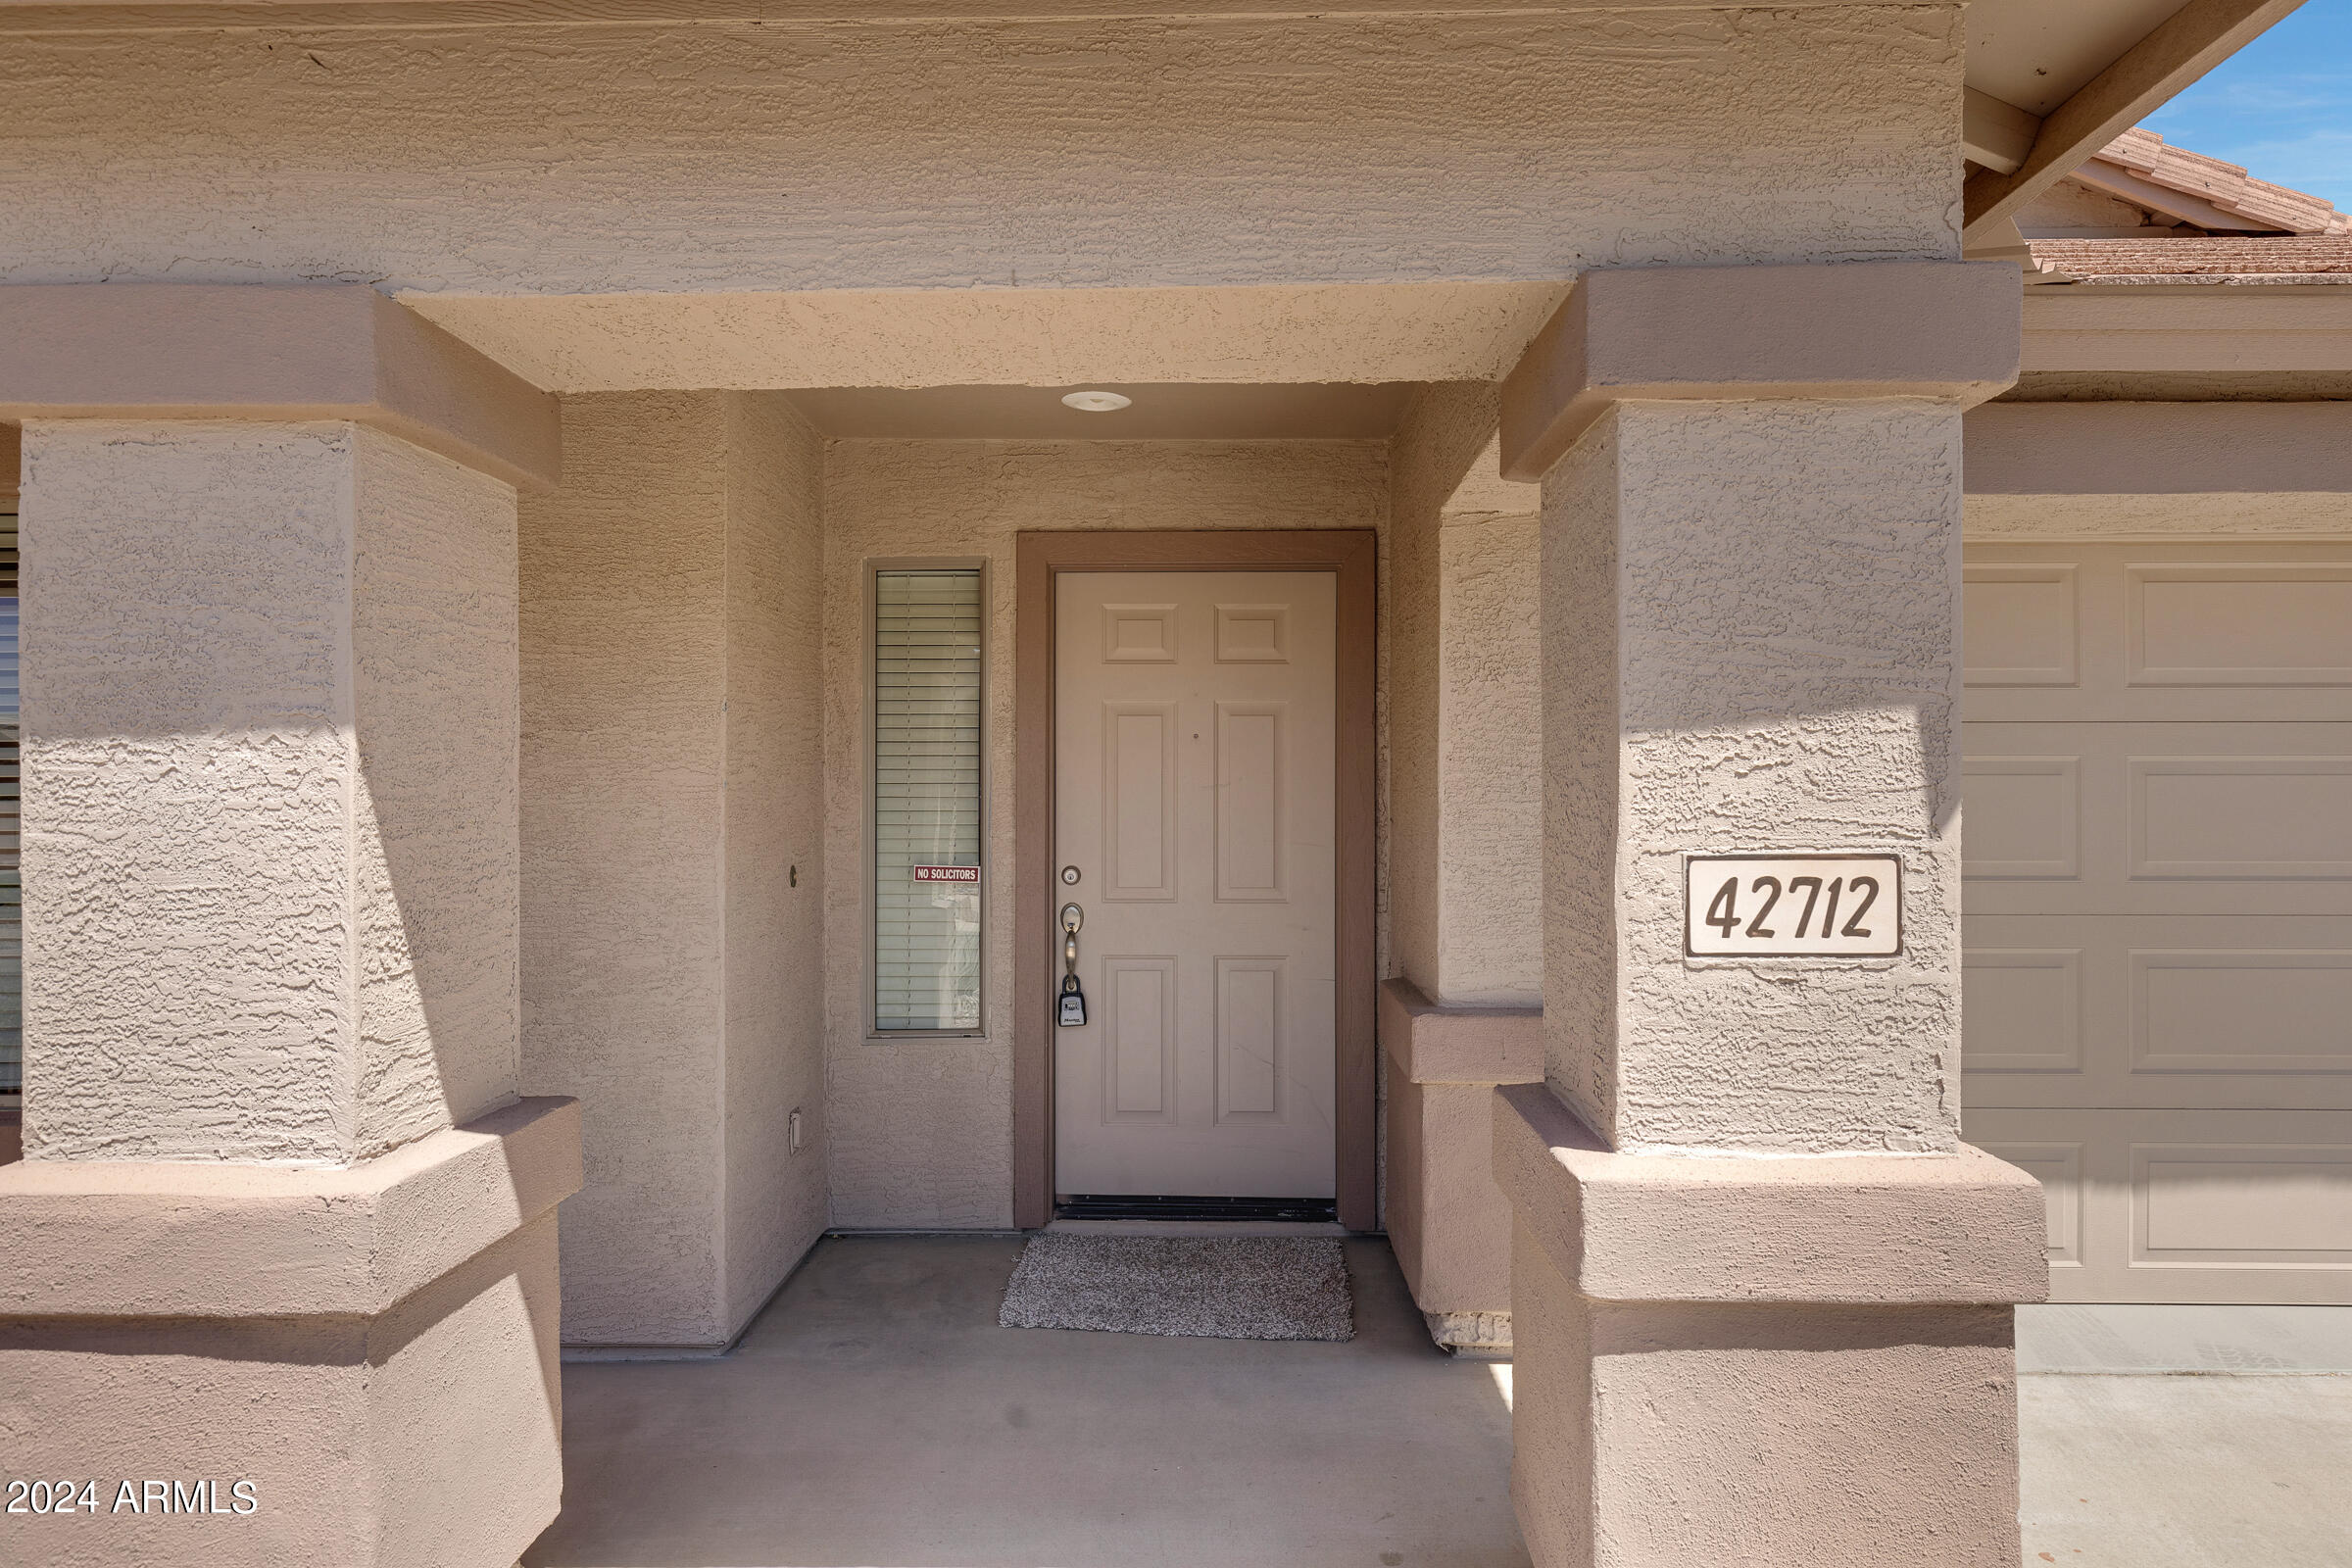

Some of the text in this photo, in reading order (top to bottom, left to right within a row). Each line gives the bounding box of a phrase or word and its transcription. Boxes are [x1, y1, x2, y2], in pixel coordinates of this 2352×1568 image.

[917, 868, 976, 880] NO SOLICITORS
[1705, 875, 1880, 939] 42712
